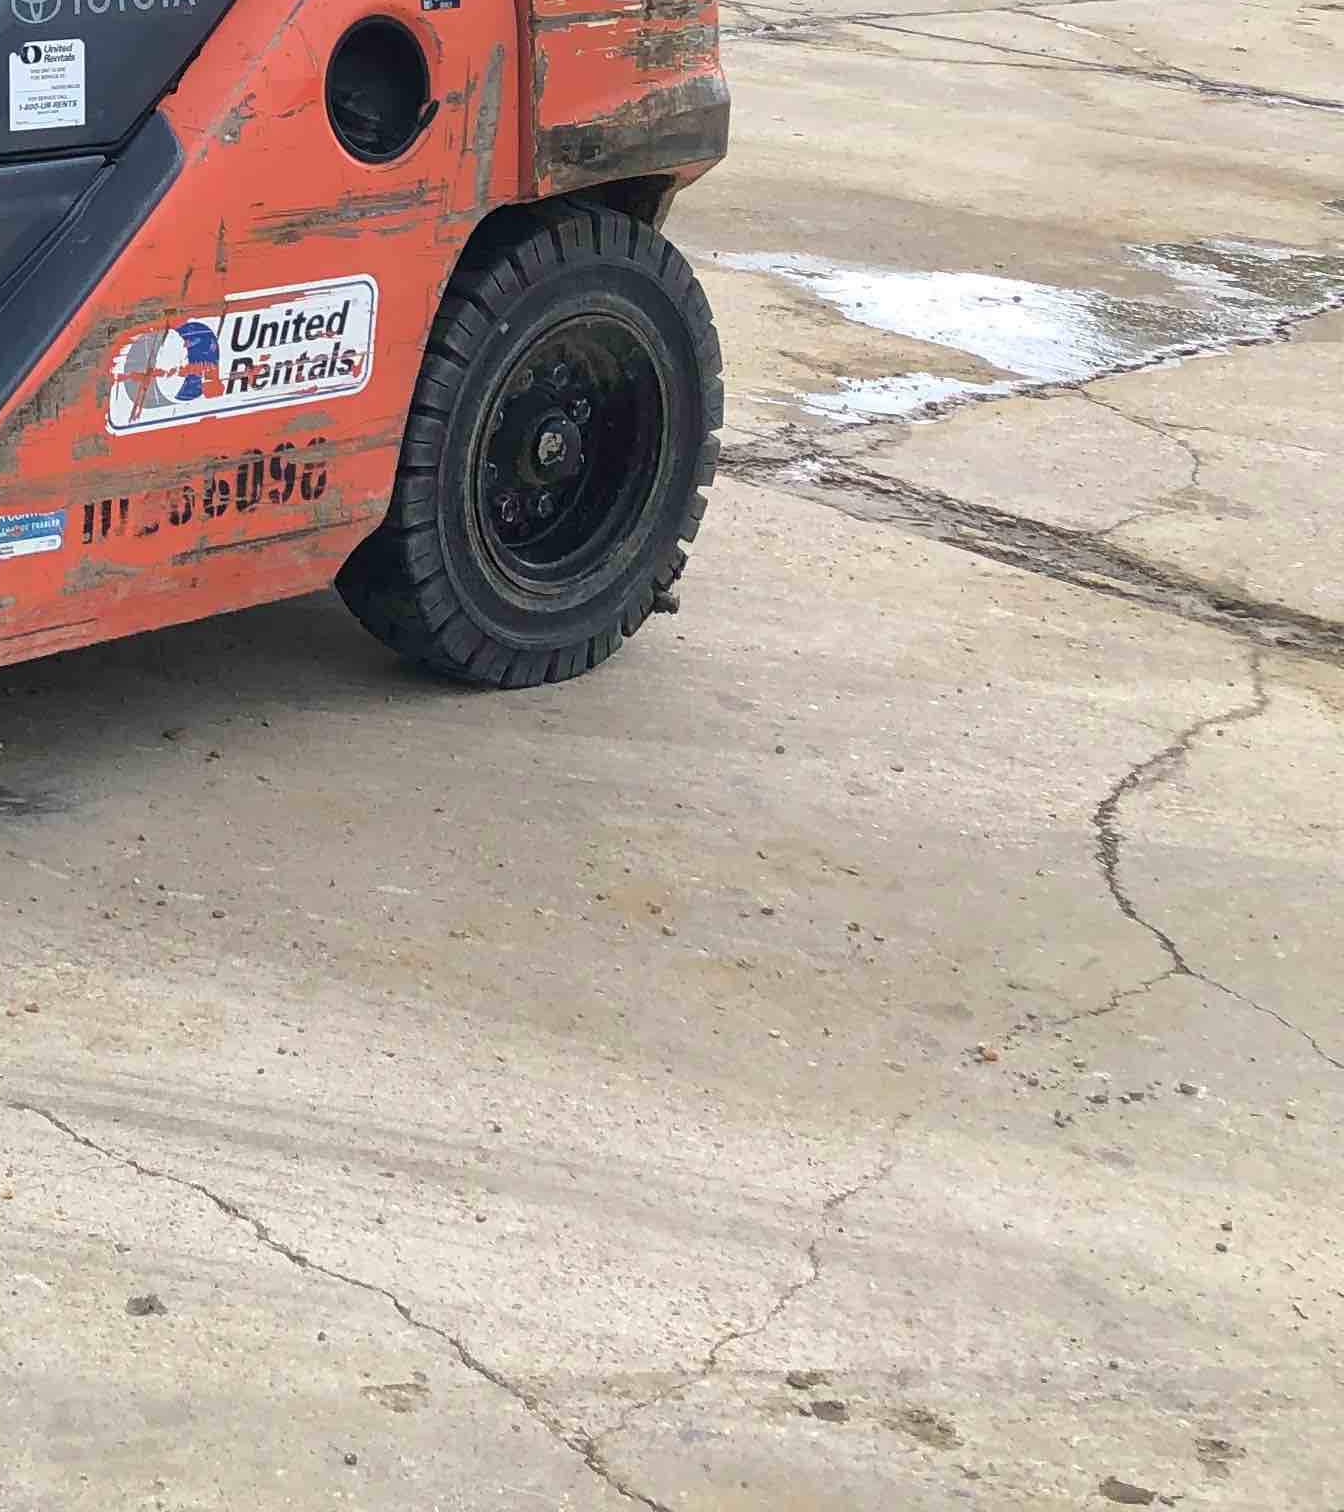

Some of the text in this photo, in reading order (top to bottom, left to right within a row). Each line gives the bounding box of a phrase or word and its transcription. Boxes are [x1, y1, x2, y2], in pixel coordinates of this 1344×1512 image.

[43, 53, 76, 64] Rentals
[44, 43, 73, 53] United
[229, 300, 351, 352] United
[225, 342, 357, 394] Rentals
